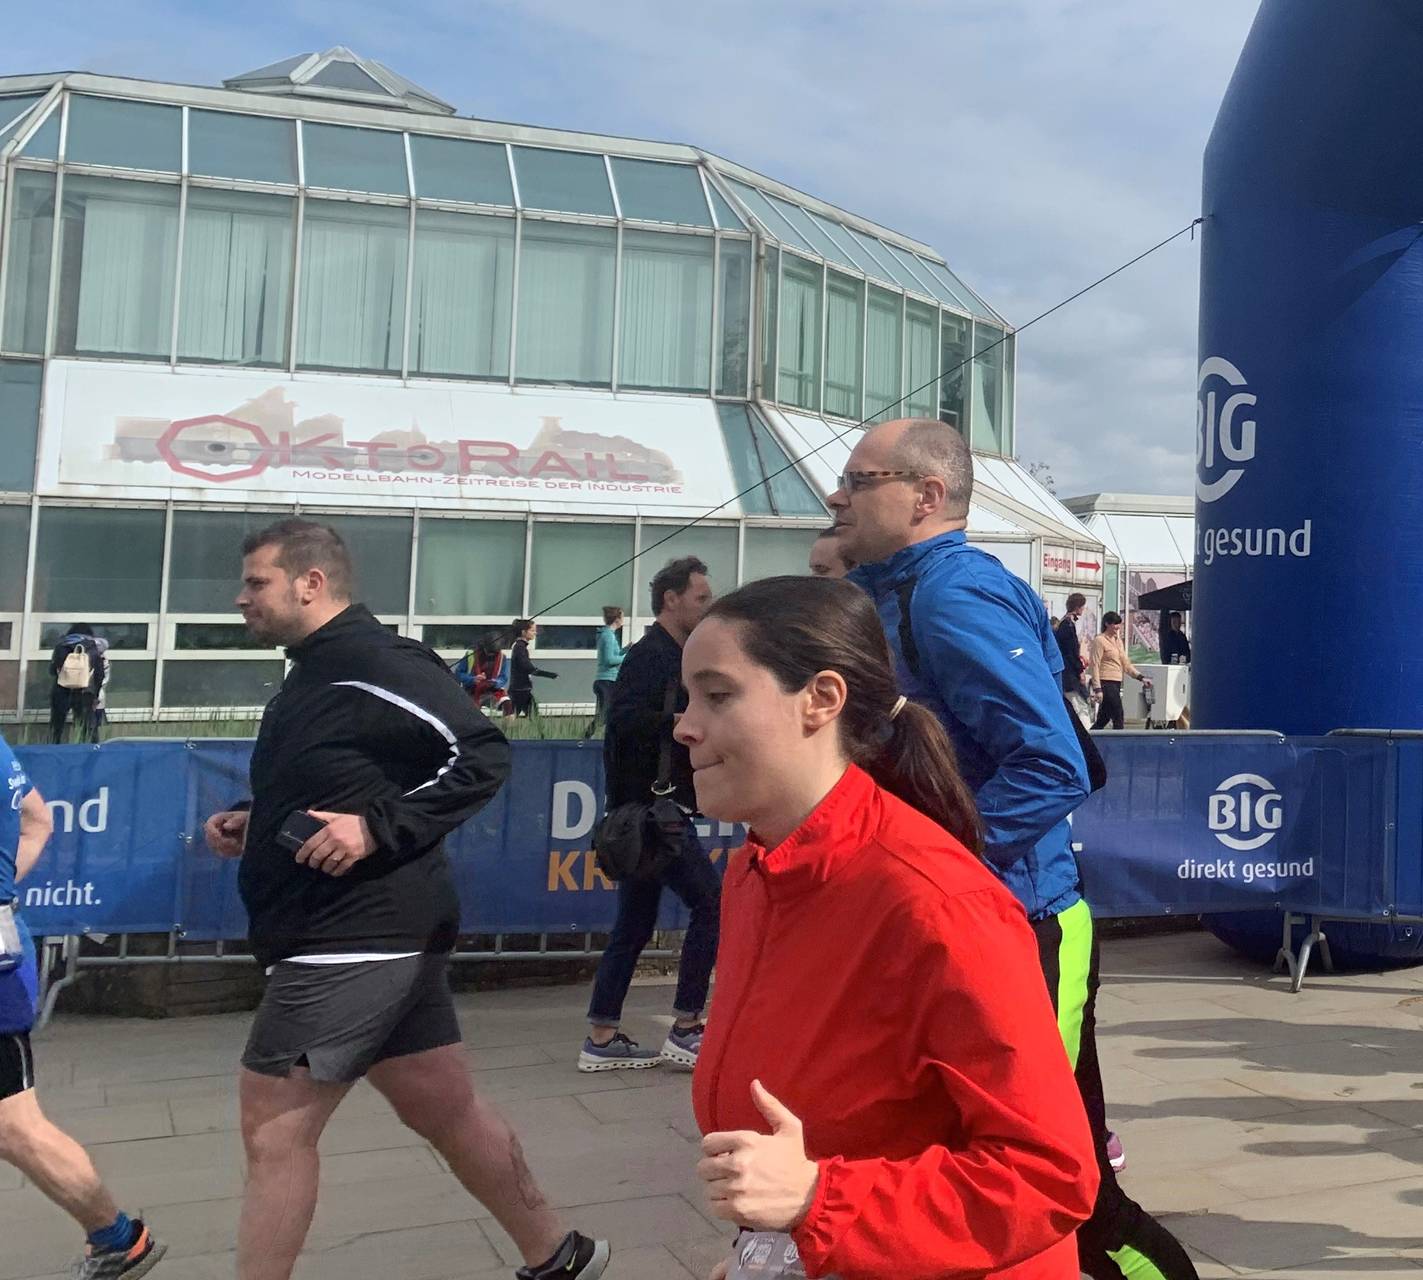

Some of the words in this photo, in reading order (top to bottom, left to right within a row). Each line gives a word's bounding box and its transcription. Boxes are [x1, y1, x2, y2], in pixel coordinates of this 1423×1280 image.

[1196, 391, 1257, 468] IG
[544, 481, 583, 490] DER
[1203, 519, 1312, 566] gesund
[1043, 553, 1071, 573] Eingang
[1208, 791, 1283, 833] BIG
[1177, 859, 1236, 879] direkt
[1242, 857, 1314, 884] gesund
[25, 879, 102, 907] nicht.
